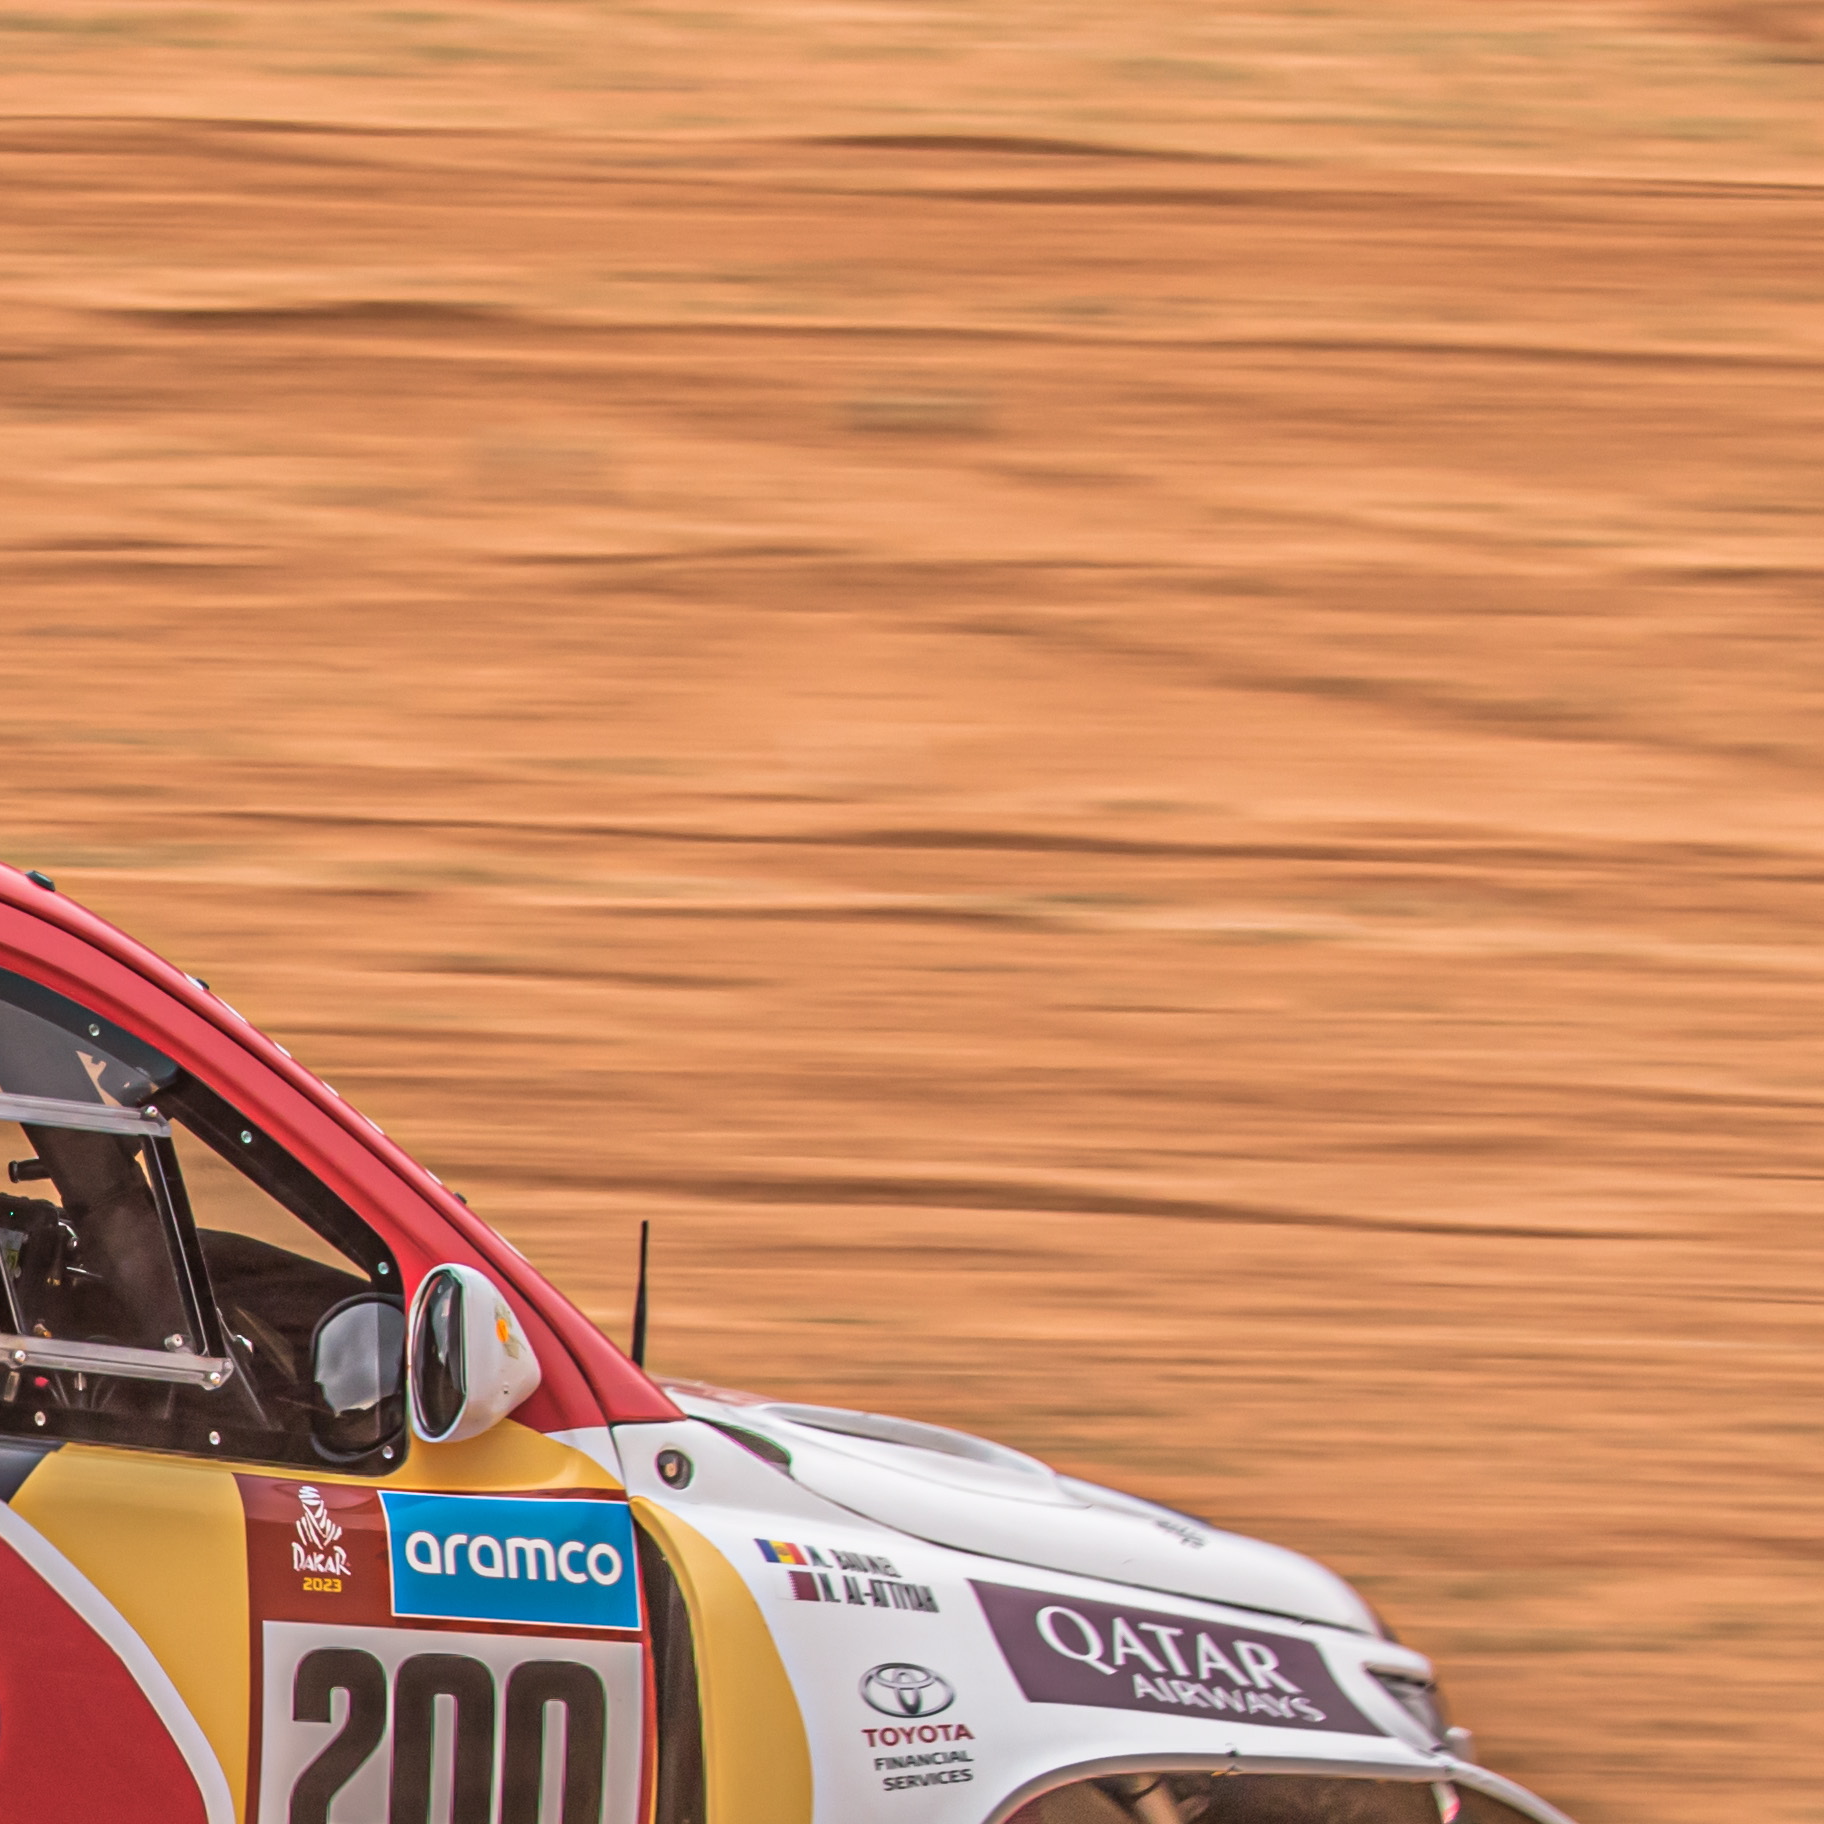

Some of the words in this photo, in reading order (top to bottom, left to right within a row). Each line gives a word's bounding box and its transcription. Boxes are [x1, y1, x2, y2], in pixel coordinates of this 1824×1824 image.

[292, 1541, 351, 1575] DAKAR
[404, 1531, 623, 1587] aramco
[303, 1577, 342, 1592] 2023
[1036, 1606, 1303, 1694] QATAR
[1133, 1673, 1327, 1723] AIRWAYS
[861, 1724, 975, 1747] TOYOTA
[873, 1750, 975, 1771] FINANCIAL
[883, 1768, 974, 1791] SERVICES
